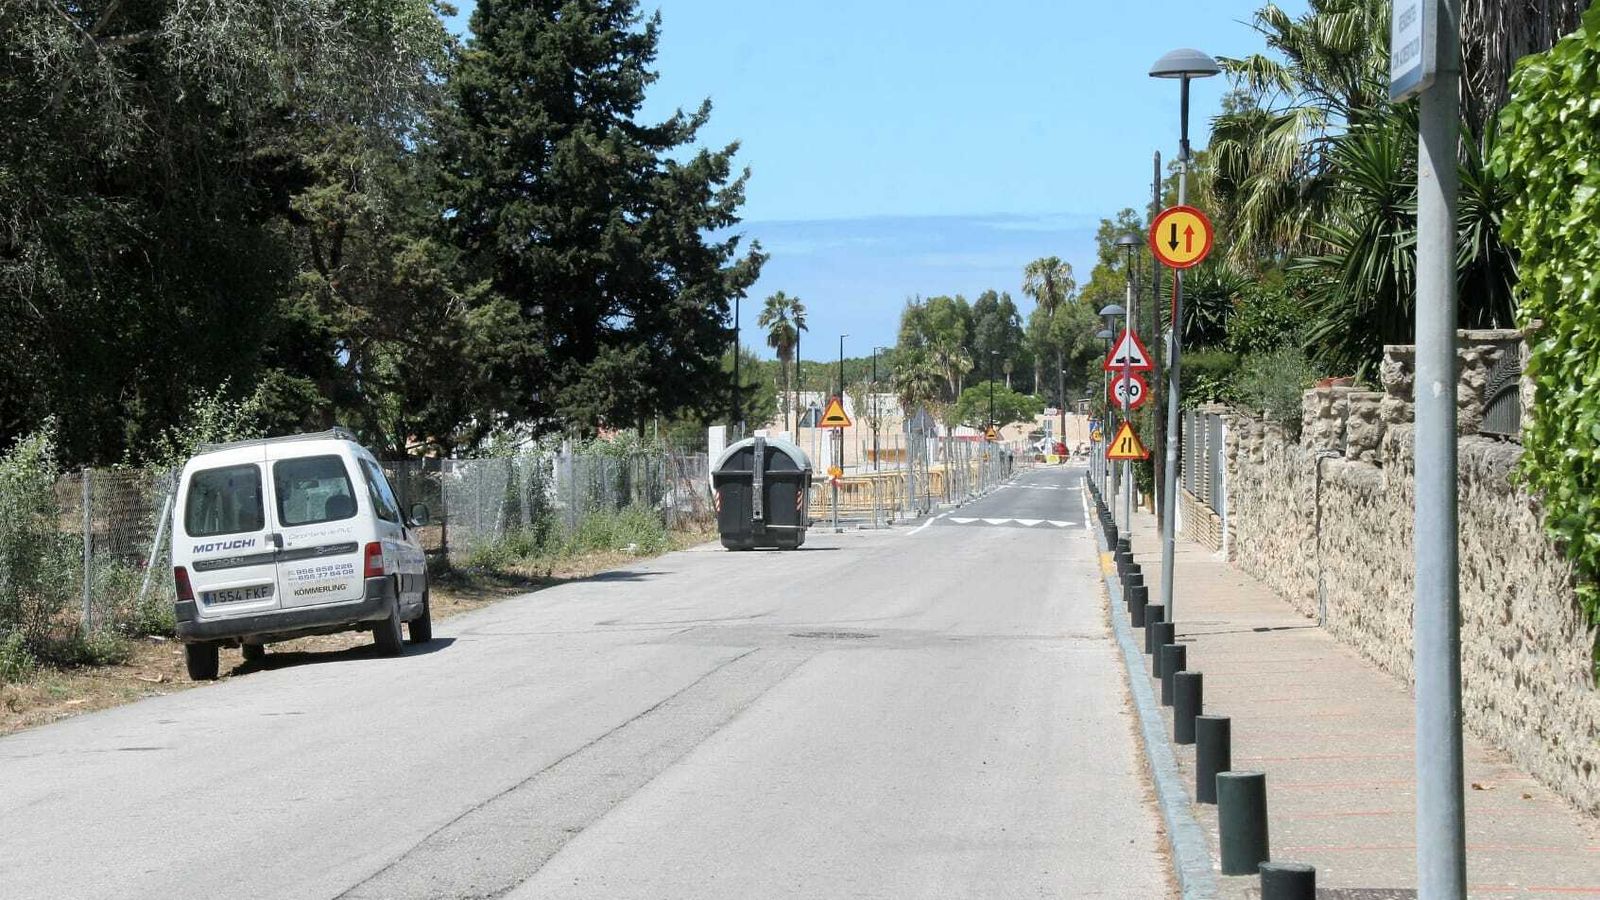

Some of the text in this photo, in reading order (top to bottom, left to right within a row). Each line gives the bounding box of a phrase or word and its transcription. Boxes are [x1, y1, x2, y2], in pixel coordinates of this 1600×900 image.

[193, 539, 255, 553] MOTUCHI
[213, 590, 241, 603] 1554
[245, 586, 268, 600] FKF
